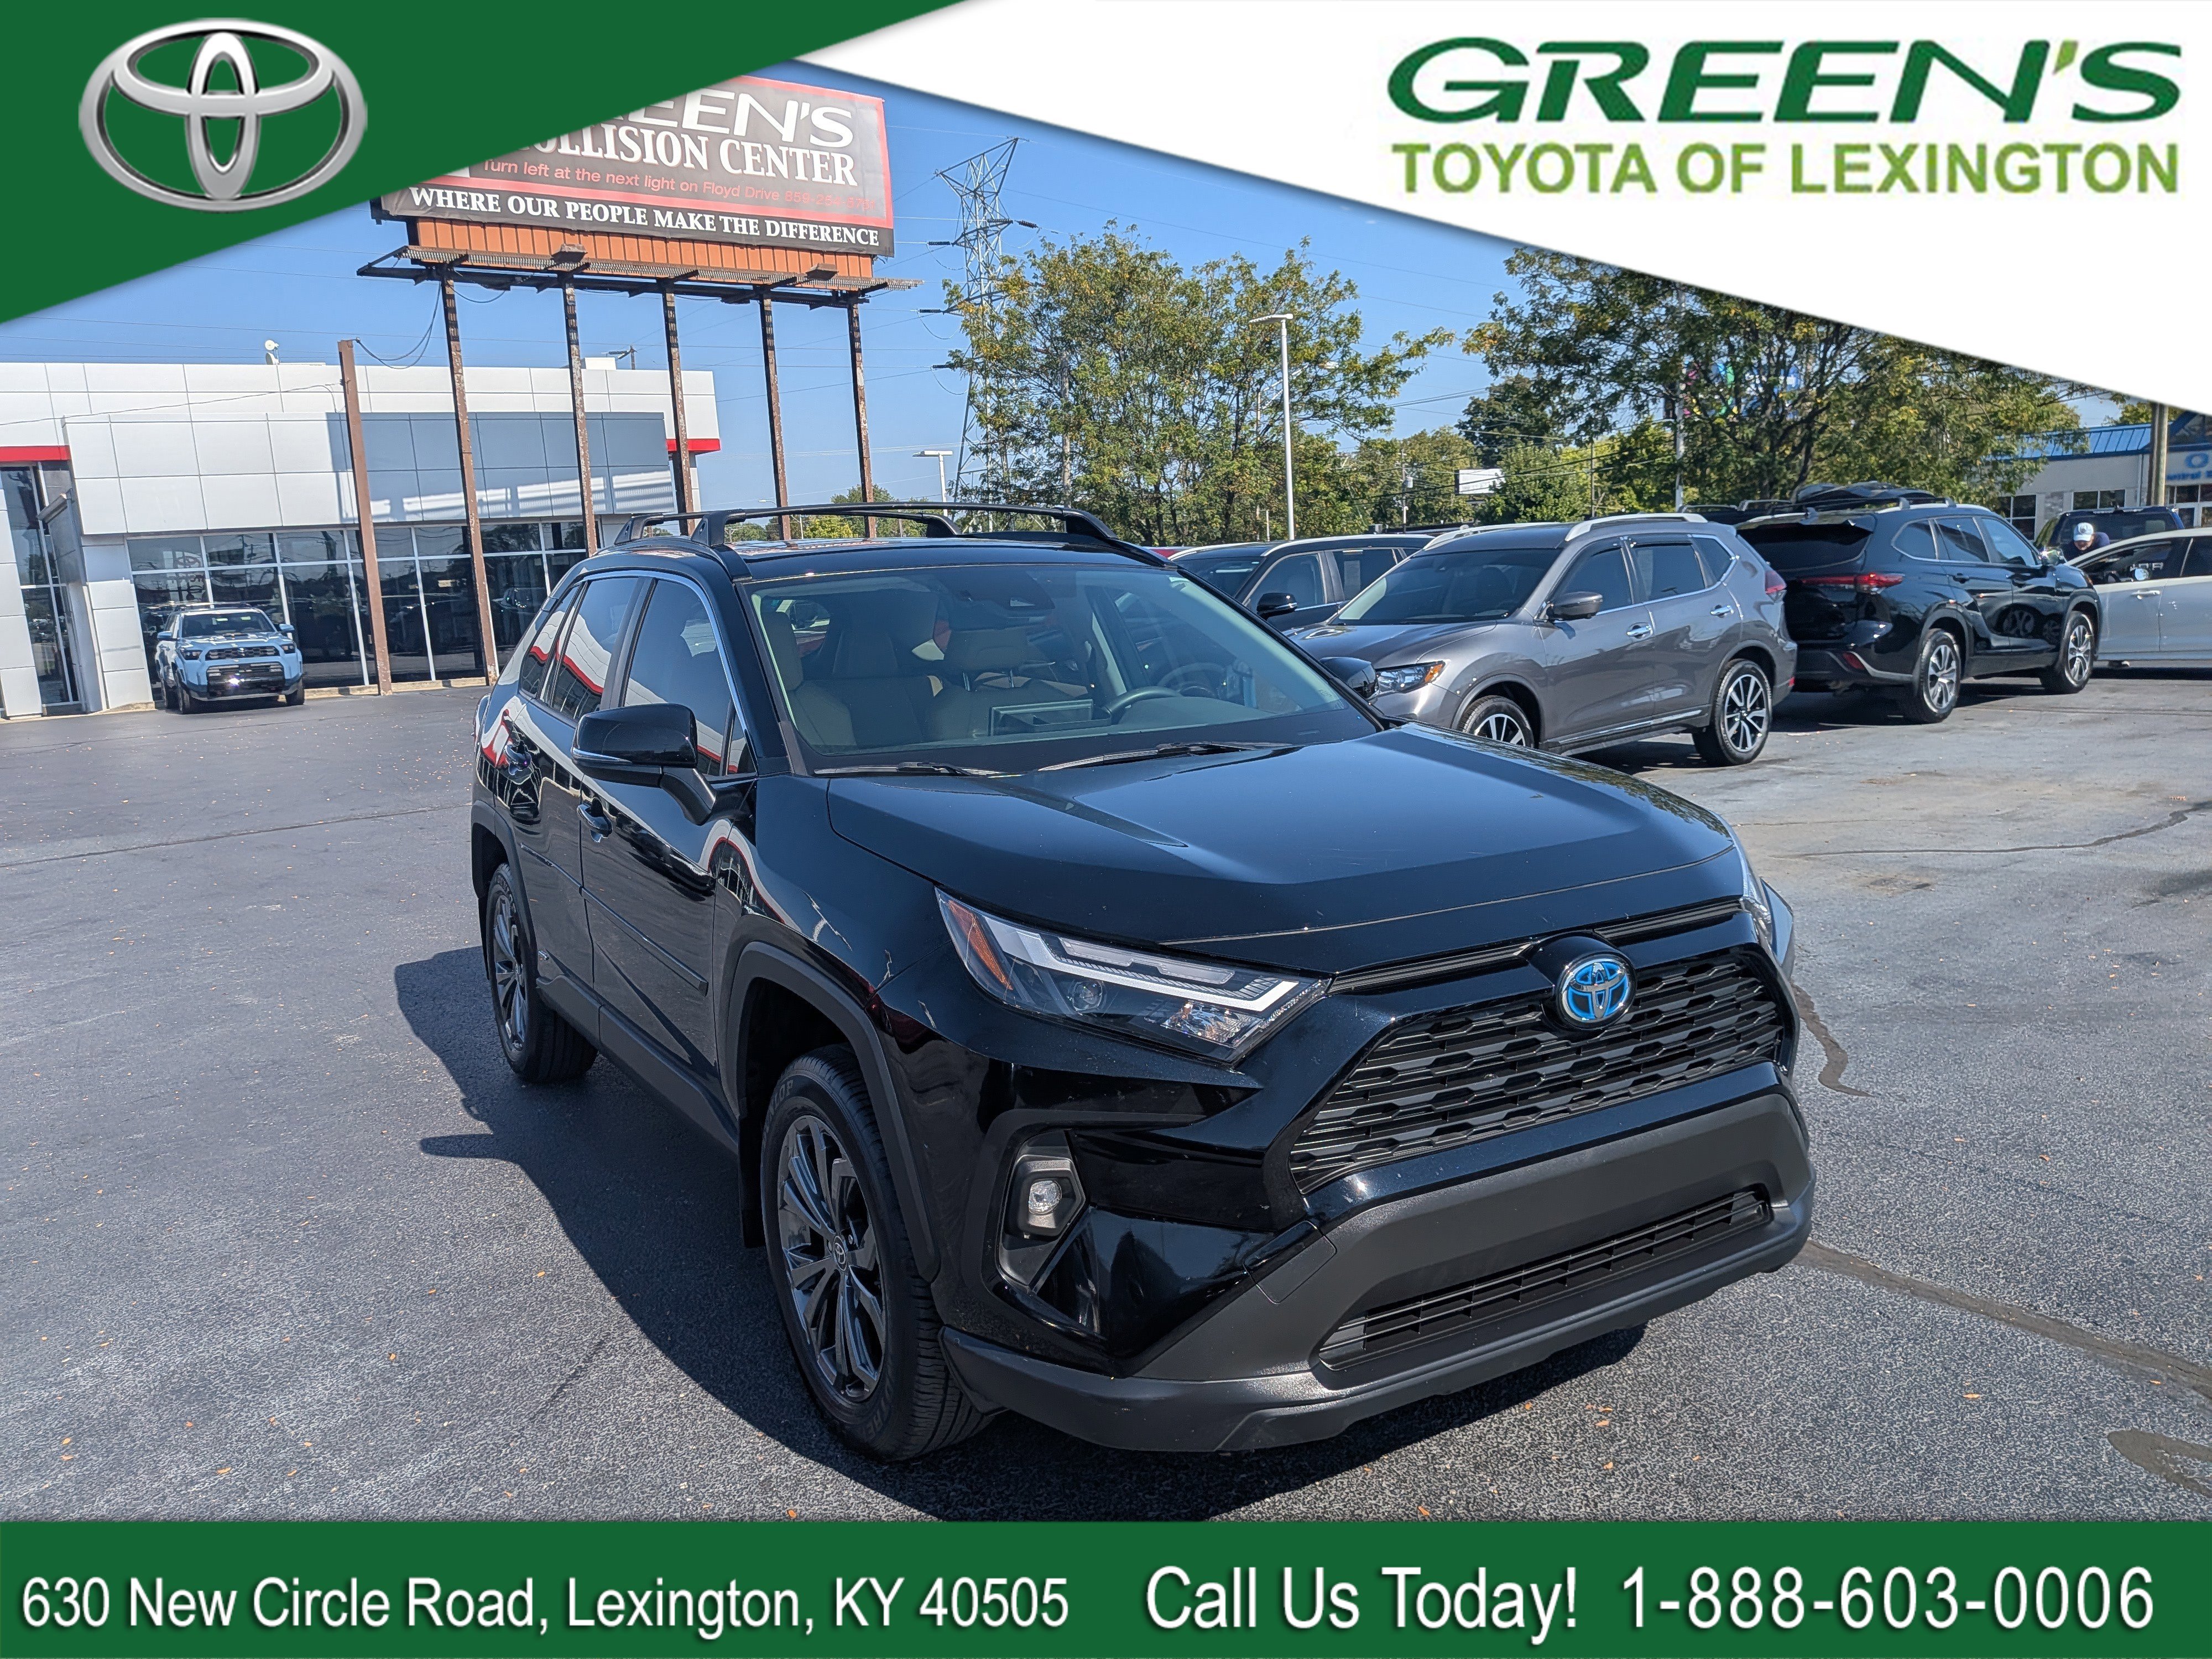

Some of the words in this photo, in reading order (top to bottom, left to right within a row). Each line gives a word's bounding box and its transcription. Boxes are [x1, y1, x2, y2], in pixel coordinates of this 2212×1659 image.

[524, 162, 550, 177] left
[554, 166, 571, 180] at
[575, 168, 601, 182] the
[606, 173, 640, 187] next
[644, 176, 675, 192] light
[680, 182, 698, 192] on
[702, 181, 740, 197] Floyd
[744, 187, 780, 201] Drive
[719, 138, 858, 187] CENTER
[409, 187, 501, 213] WHERE
[508, 196, 560, 218] OUR
[565, 201, 648, 226] PEOPLE
[654, 210, 717, 232] MAKE
[719, 216, 760, 236] THE
[764, 220, 879, 247] DIFFERENCE
